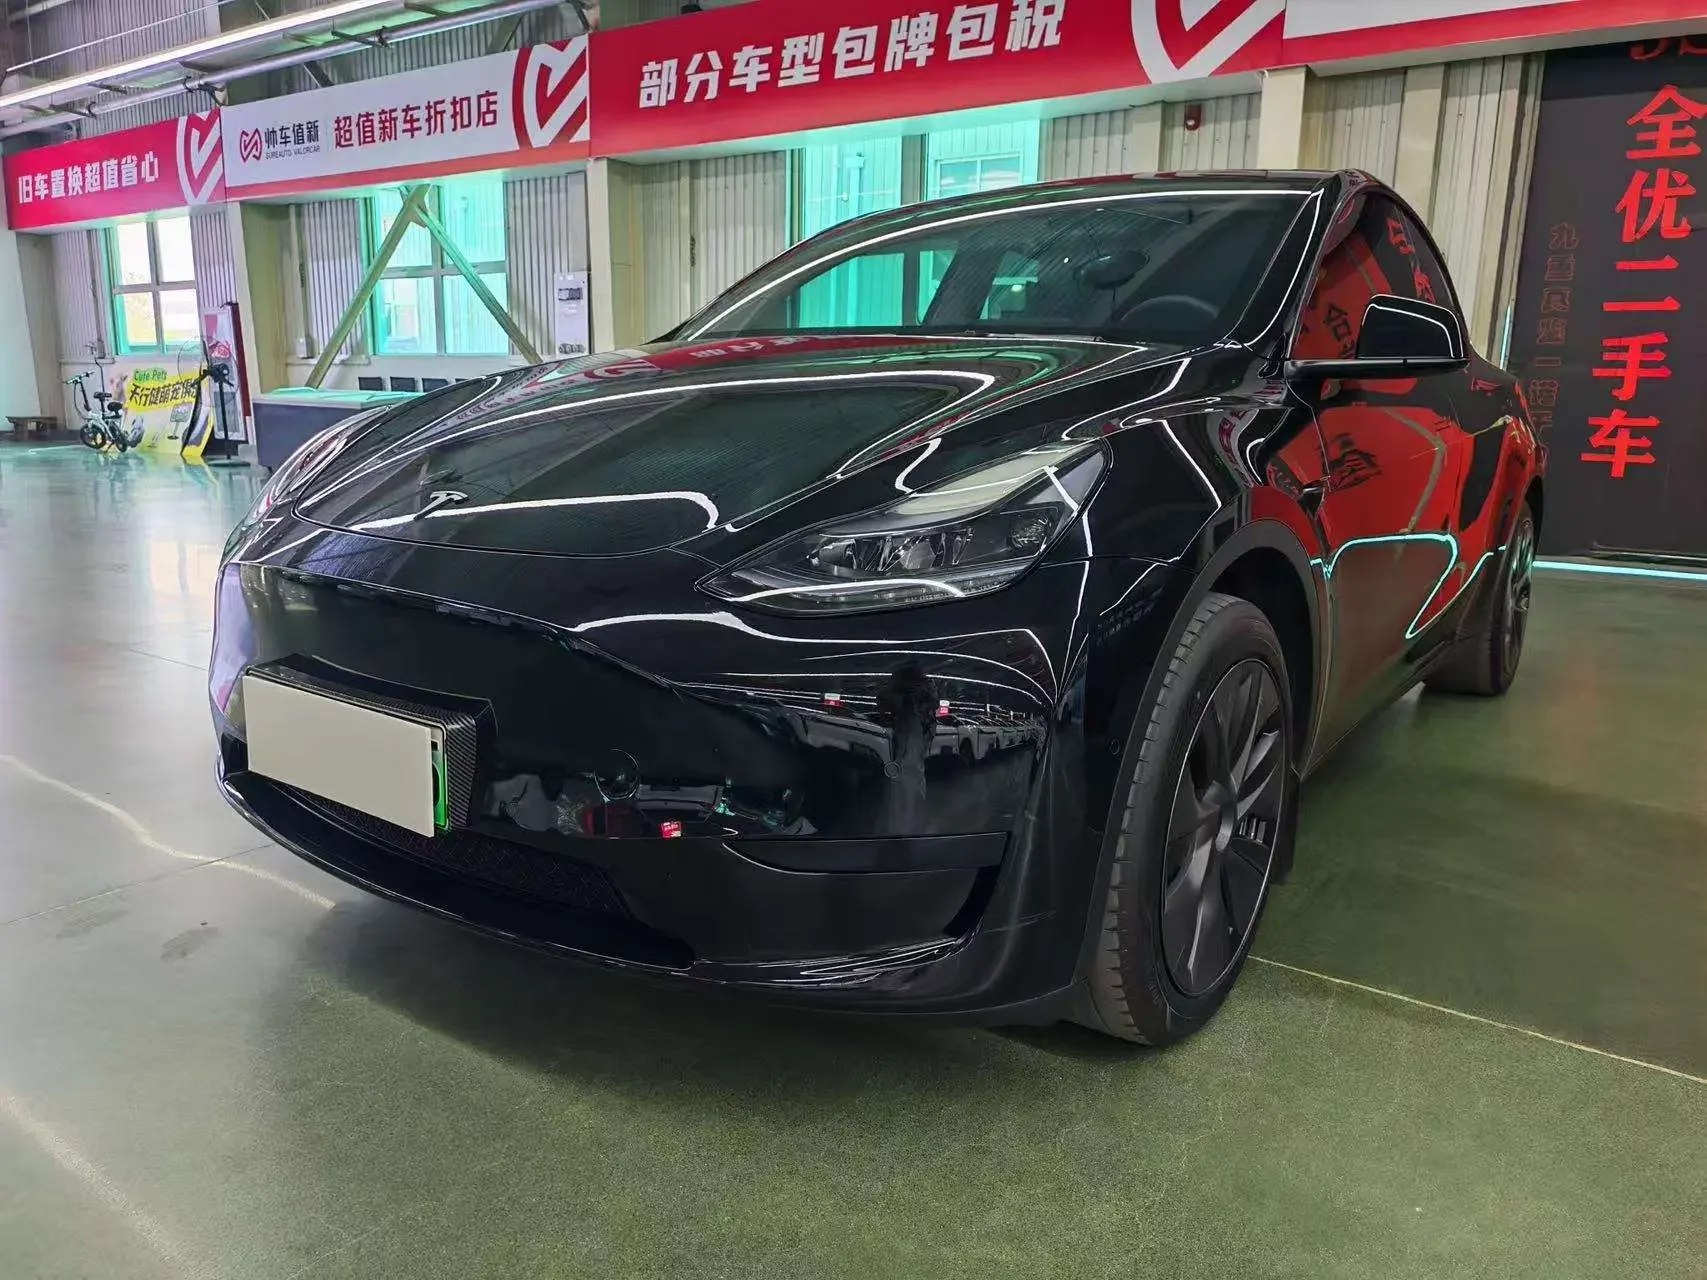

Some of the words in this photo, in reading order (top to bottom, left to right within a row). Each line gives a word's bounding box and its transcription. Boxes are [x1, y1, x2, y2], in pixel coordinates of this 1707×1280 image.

[638, 0, 1066, 109] 部分车型包牌包税
[264, 119, 319, 149] 帅车值新
[334, 90, 499, 149] 超值新车折扣店
[18, 150, 159, 203] 旧车置换超值省心
[1580, 84, 1707, 478] 全优二手车
